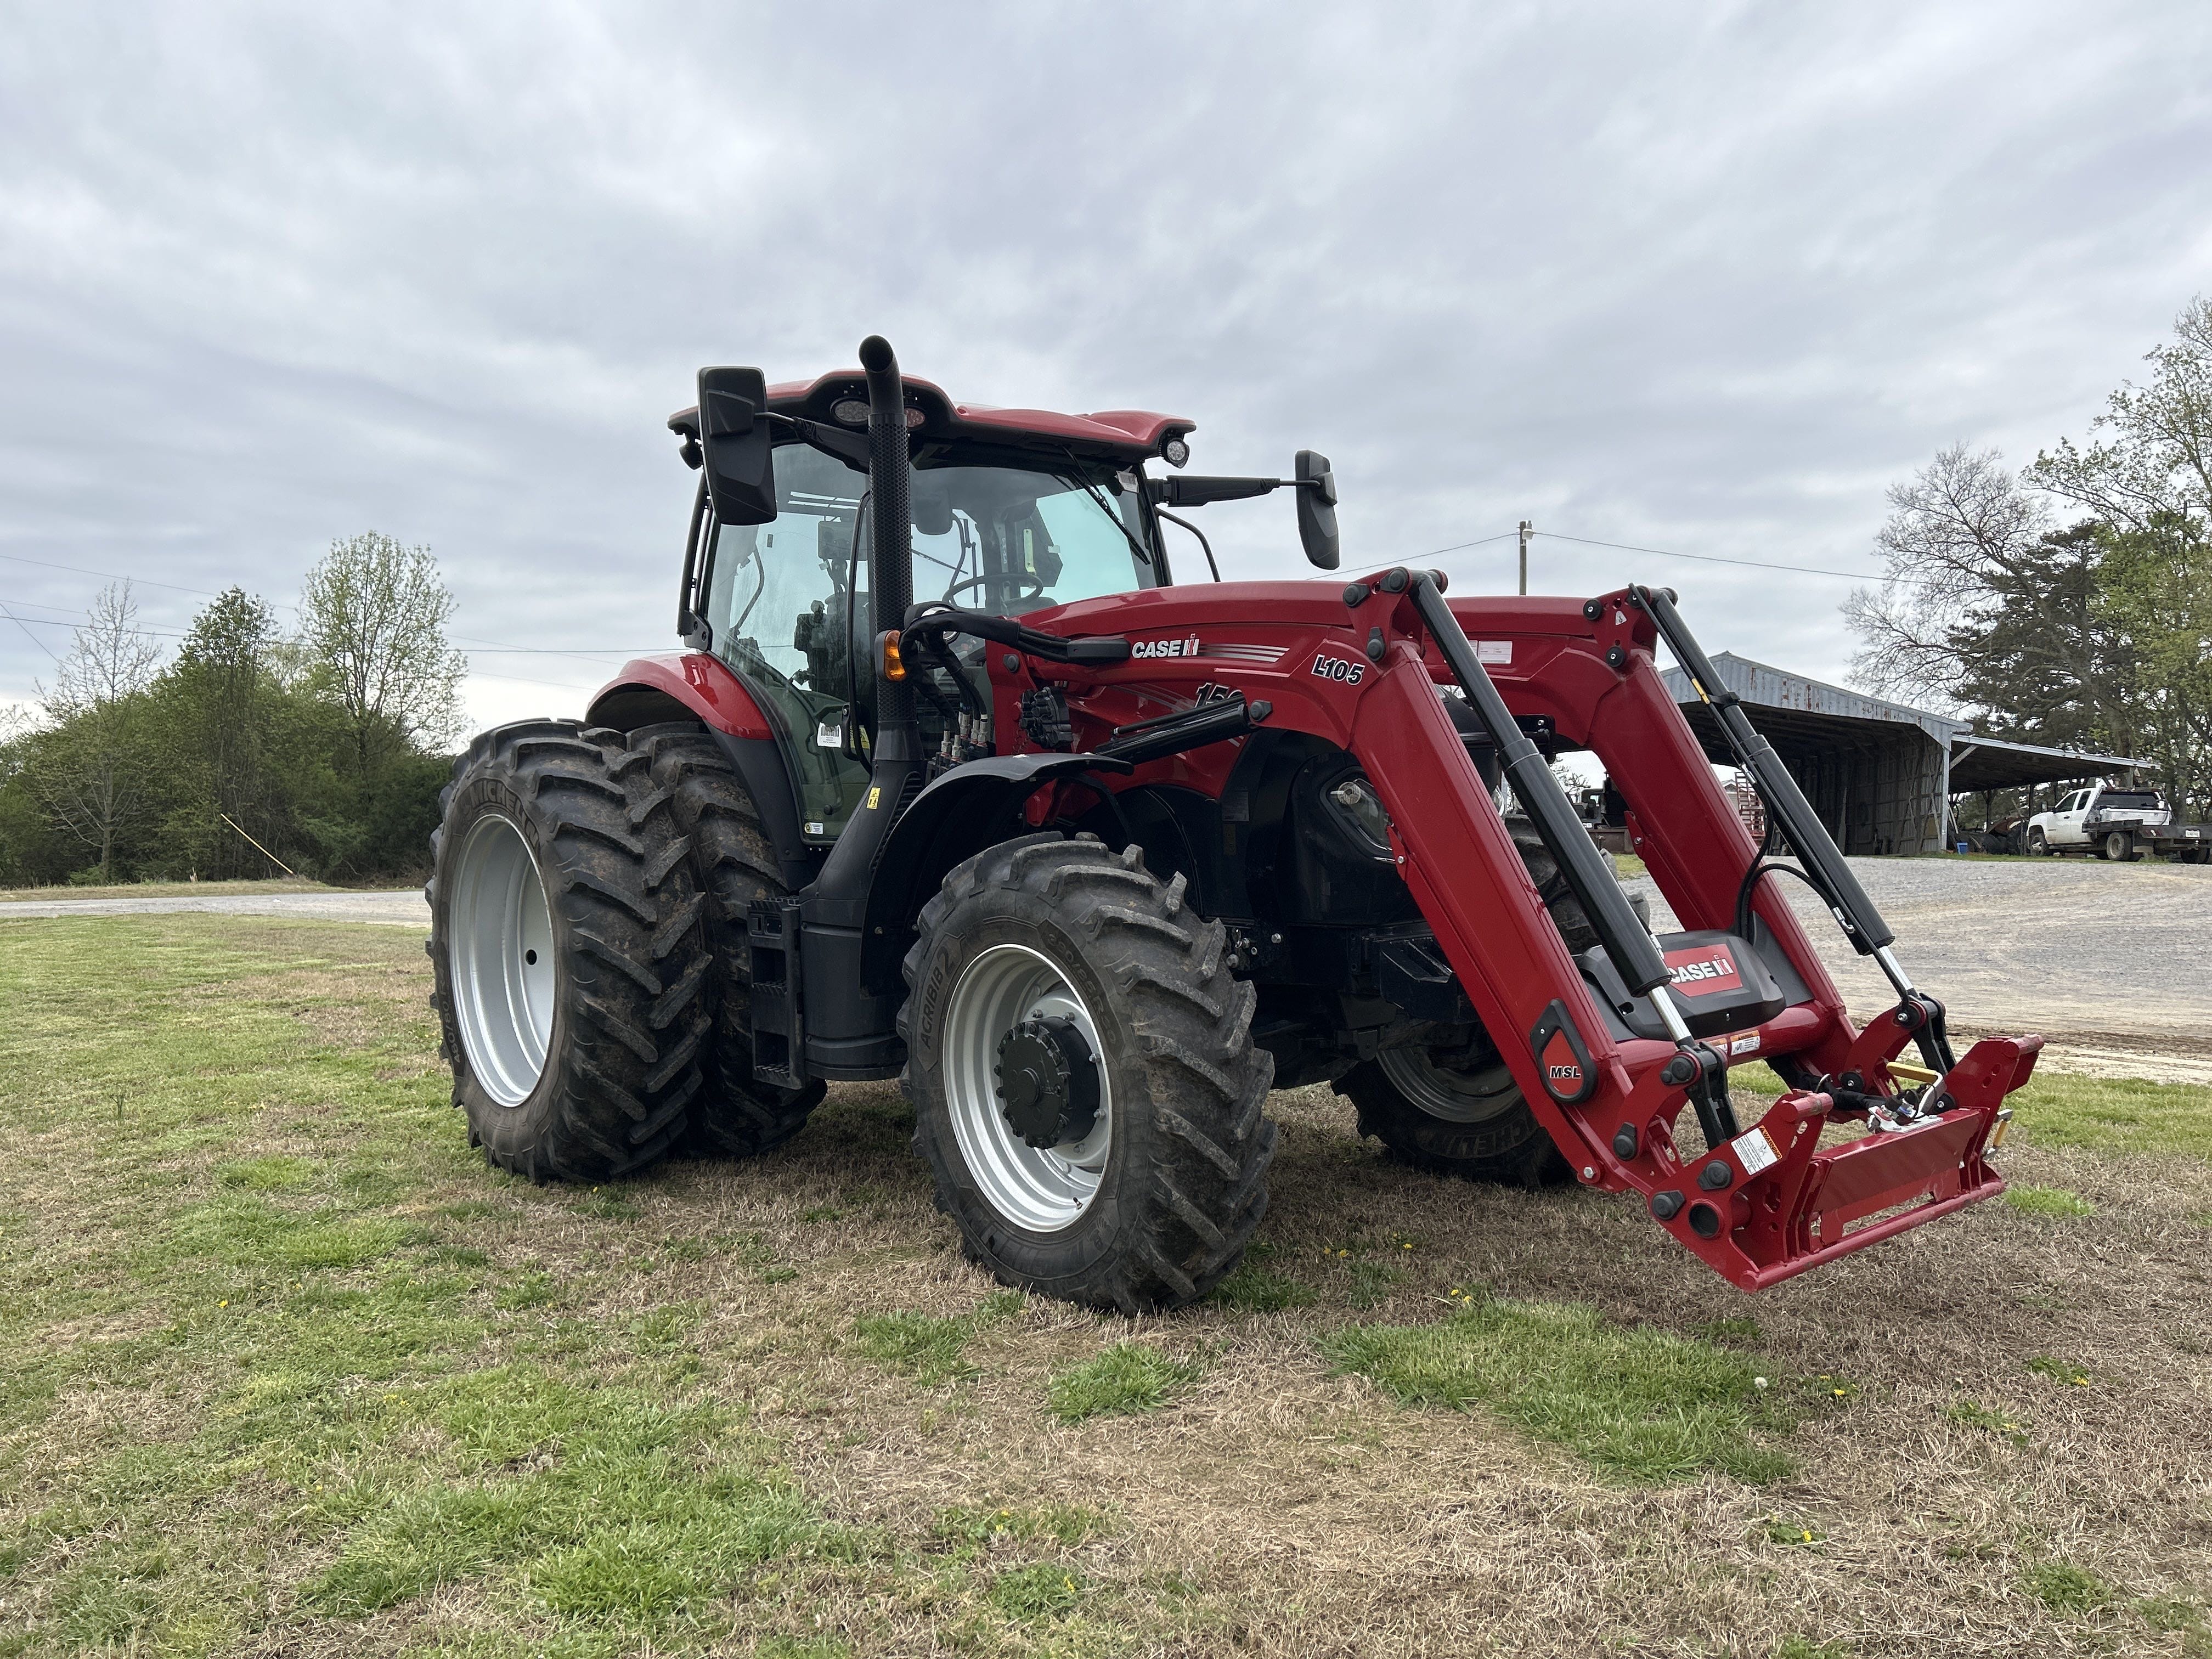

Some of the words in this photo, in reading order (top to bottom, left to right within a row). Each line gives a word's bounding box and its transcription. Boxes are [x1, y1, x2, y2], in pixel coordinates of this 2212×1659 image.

[1131, 640, 1182, 658] CASE
[1311, 653, 1366, 686] L105
[469, 780, 539, 848] MICHELIN
[1667, 961, 1717, 984] CASE
[921, 966, 944, 1050] AGRIBIB
[937, 946, 955, 978] 2
[442, 1000, 461, 1063] 480/80
[1549, 1065, 1582, 1079] MSL
[1763, 1131, 1782, 1159] WARNING
